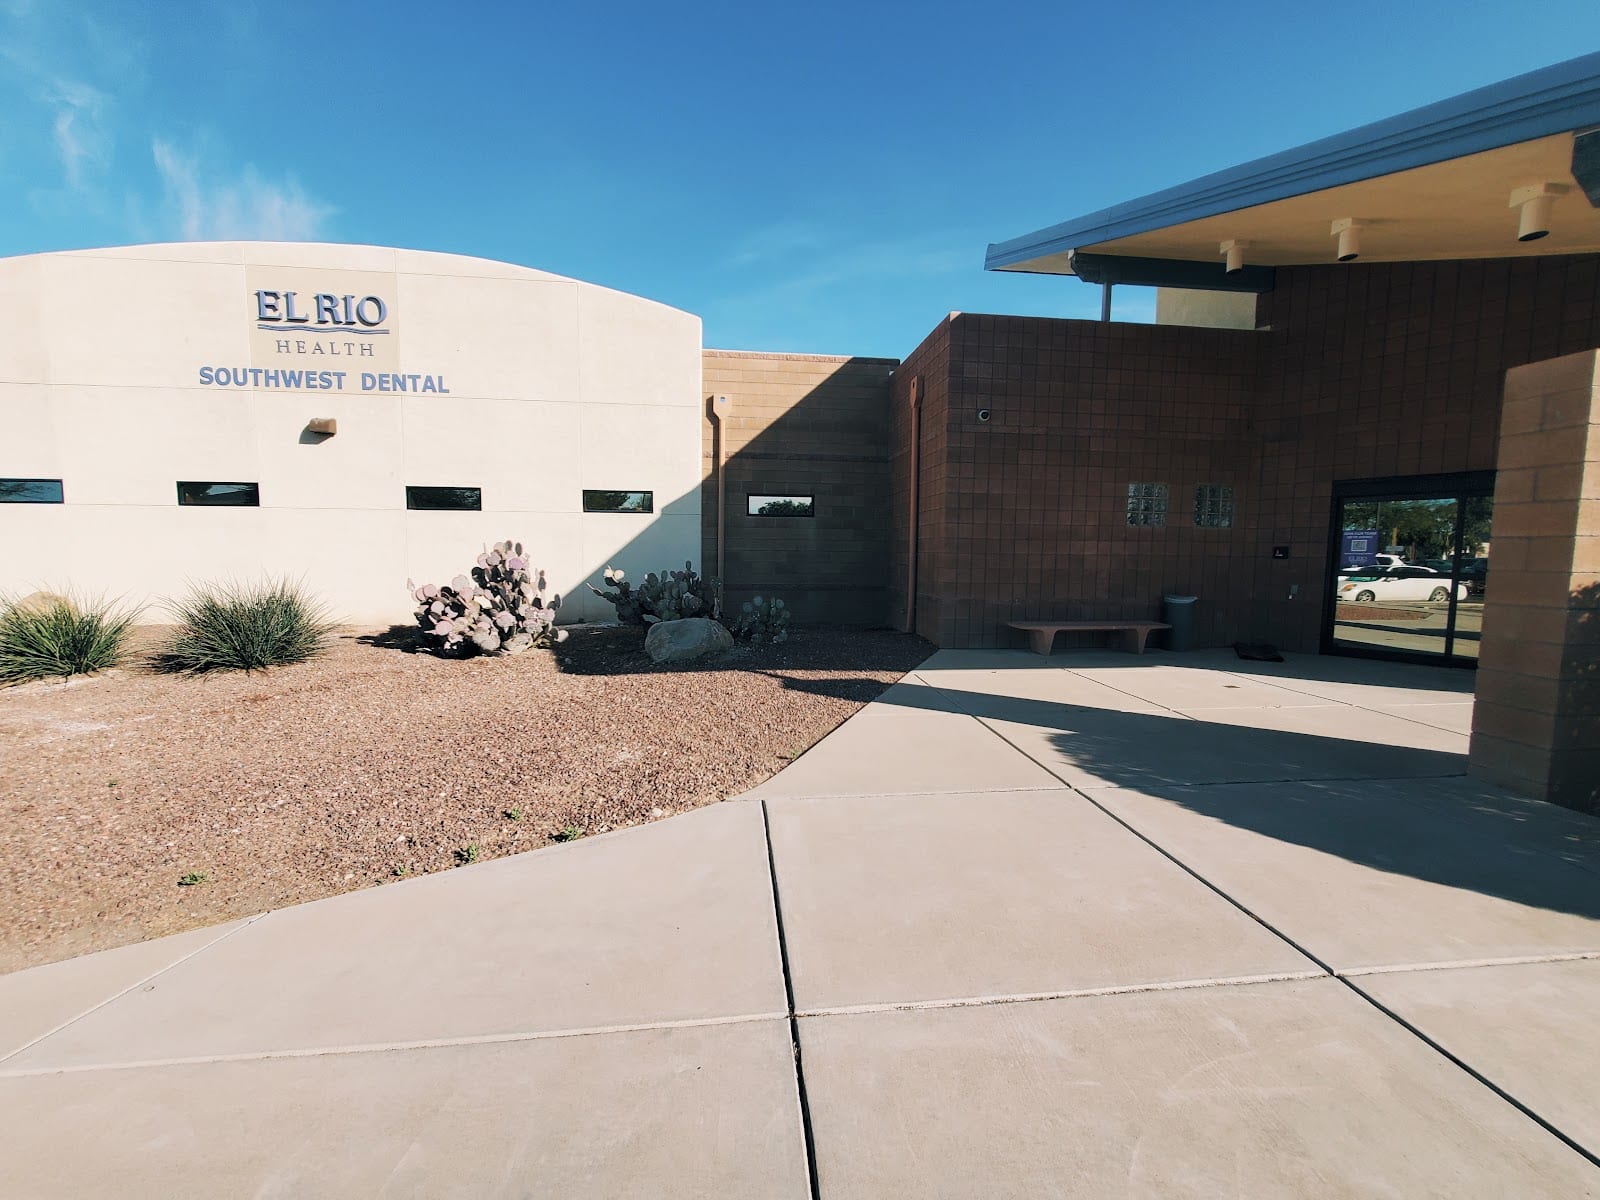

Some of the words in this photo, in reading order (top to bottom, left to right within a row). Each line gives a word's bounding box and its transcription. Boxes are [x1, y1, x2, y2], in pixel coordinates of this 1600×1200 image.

[254, 289, 309, 322] EL
[313, 293, 388, 327] RIO
[276, 339, 375, 357] HEALTH
[199, 366, 347, 390] SOUTHWEST
[361, 372, 450, 394] DENTAL
